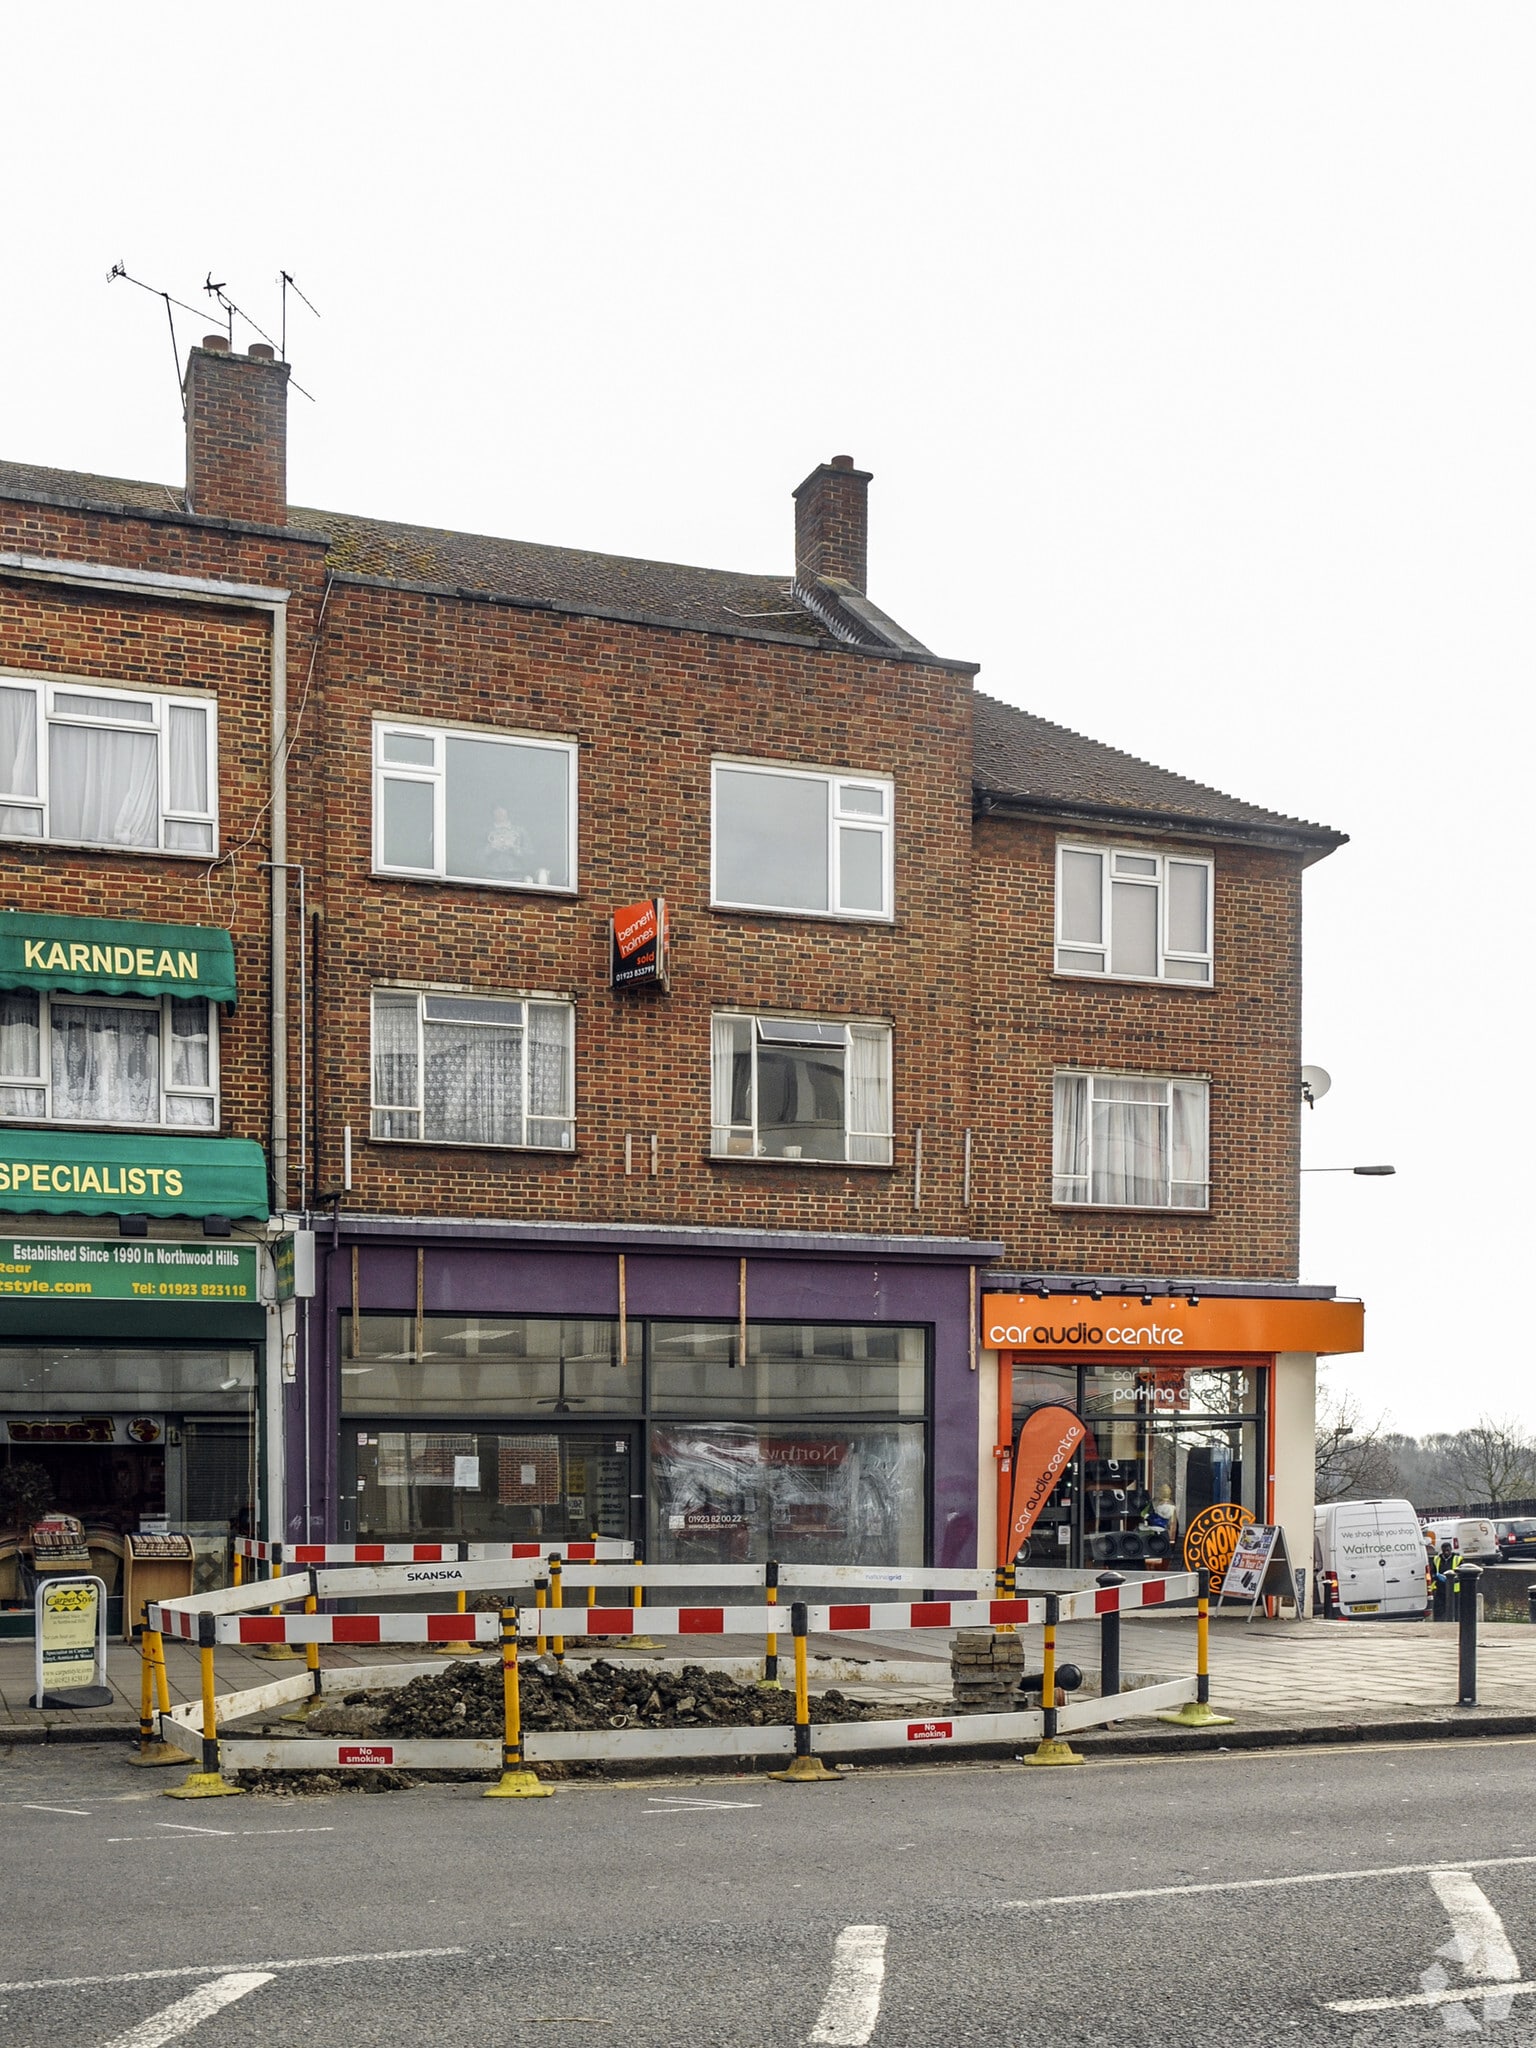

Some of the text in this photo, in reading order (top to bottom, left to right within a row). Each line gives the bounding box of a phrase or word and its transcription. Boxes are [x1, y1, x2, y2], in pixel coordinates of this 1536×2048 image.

[618, 909, 653, 941] bennett
[621, 927, 654, 955] holmes
[24, 940, 198, 979] KARNDEAN
[636, 951, 655, 965] sold
[616, 970, 633, 981] 01923
[0, 1163, 183, 1196] SPECIALISTS
[13, 1244, 239, 1266] Established Since 1990 In Northwood Hills
[132, 1282, 156, 1294] Tel:
[159, 1283, 198, 1295] 01923
[201, 1284, 247, 1296] 823118
[990, 1323, 1184, 1345] car audio centre
[1113, 1385, 1174, 1402] parking
[688, 1515, 710, 1523] 01923
[1355, 1530, 1373, 1538] shop
[1399, 1528, 1415, 1536] shop
[1206, 1526, 1241, 1558] NOW
[1343, 1543, 1416, 1555] Waitrose.com
[407, 1570, 462, 1581] SKANSKA
[914, 1730, 946, 1739] smoking
[360, 1747, 372, 1755] No
[346, 1755, 385, 1764] smoking
